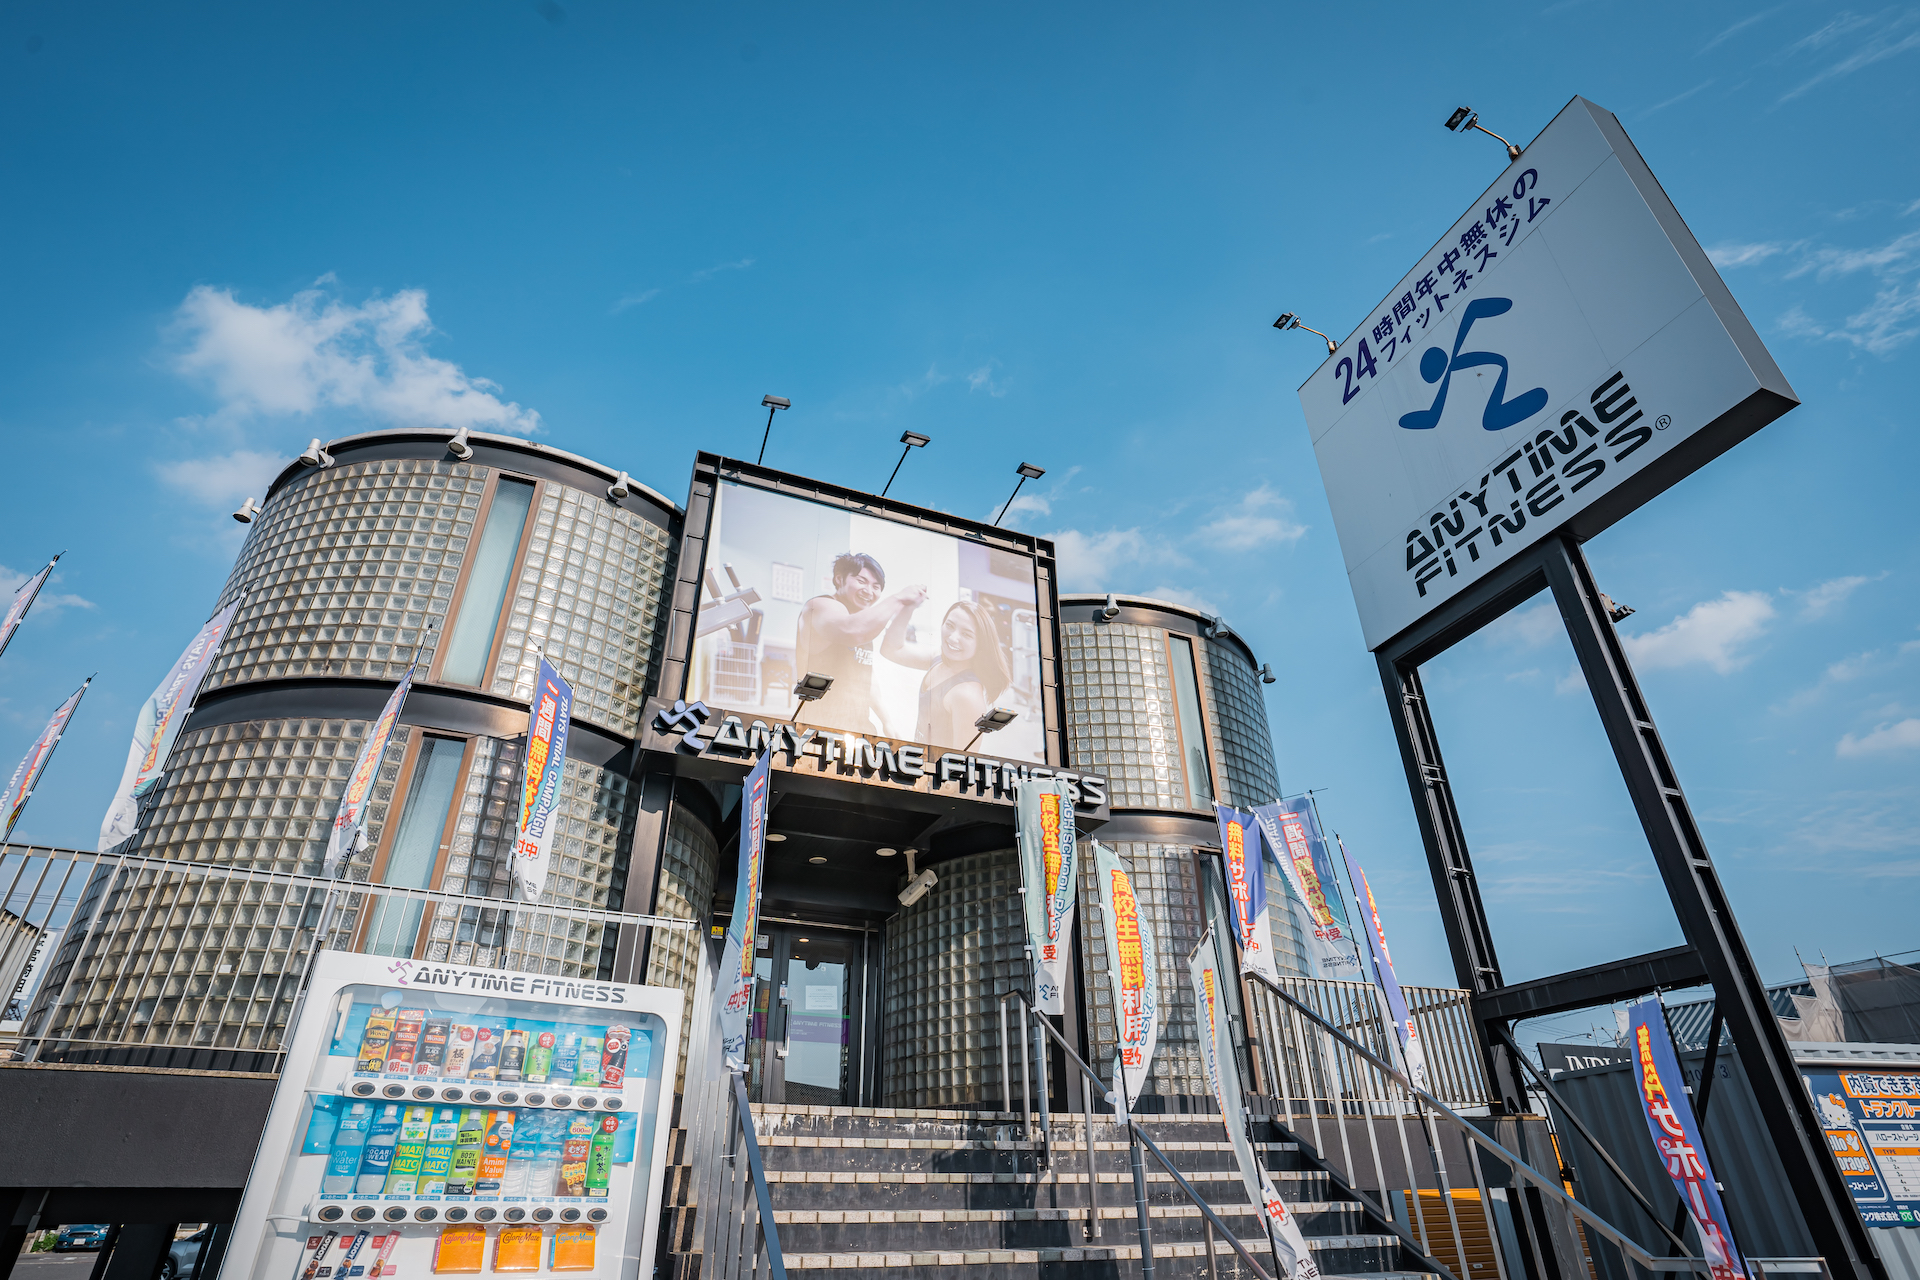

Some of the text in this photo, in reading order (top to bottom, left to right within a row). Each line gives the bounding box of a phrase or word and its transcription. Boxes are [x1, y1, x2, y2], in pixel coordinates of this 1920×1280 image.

[1334, 168, 1539, 405] 24時間年中無休の
[1380, 197, 1551, 363] フィットネスジム
[1406, 370, 1642, 572] ANYTIME
[1414, 422, 1653, 598] FITNESS
[550, 734, 563, 768] TRIAL
[712, 715, 925, 778] ANYTIME
[531, 768, 557, 838] CAMPAIGN
[1227, 820, 1256, 938] 無料サポート
[412, 966, 627, 1004] ANYTIME FITNESS
[1111, 868, 1146, 1043] 高校生無料利用
[1859, 1099, 1920, 1119] トランクルー
[1876, 1133, 1919, 1142] ハローストレージ
